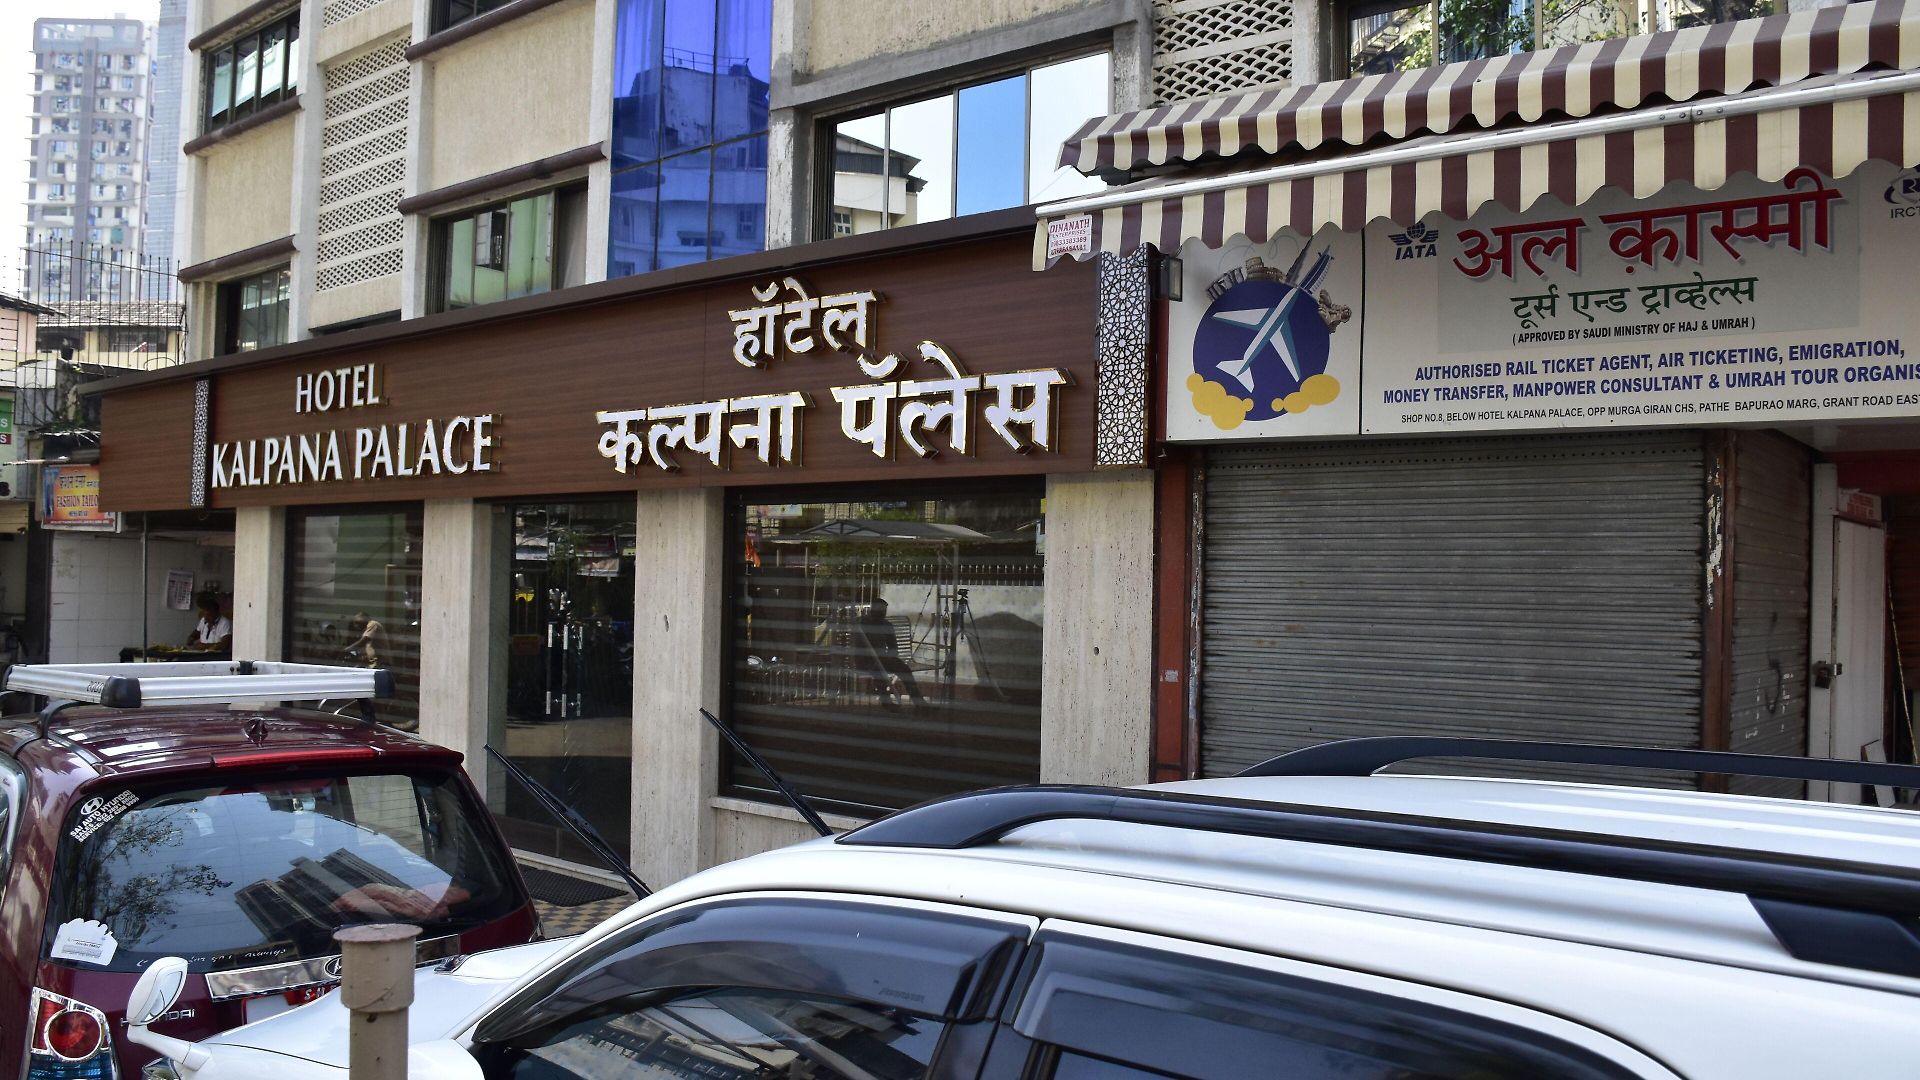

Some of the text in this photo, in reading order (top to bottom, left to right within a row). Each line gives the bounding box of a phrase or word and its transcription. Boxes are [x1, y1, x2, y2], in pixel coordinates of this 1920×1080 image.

[1050, 219, 1090, 233] DINANATH
[1453, 218, 1586, 278] अल
[1396, 244, 1436, 260] IATA
[728, 276, 878, 368] हॉटेल
[1510, 272, 1758, 330] टूर्स एन्ड ट्राव्हेल्स
[1568, 330, 1580, 340] BY
[1583, 327, 1610, 338] SAUDI
[1614, 324, 1660, 336] MINISTRY
[1663, 323, 1675, 333] OF
[1678, 321, 1698, 332] HAJ
[1702, 320, 1708, 330] &
[1415, 339, 1905, 381] AUTHORISED RAIL TICKET AGENT, AIR TICKETING, EMIGRATION,
[296, 362, 381, 413] HOTEL
[595, 340, 1069, 474] कल्पना पॅलेस
[1384, 388, 1429, 404] MONEY
[1434, 385, 1508, 401] TRANSFER,
[1513, 380, 1595, 398] MANPOWER
[1600, 375, 1703, 394] CONSULTANT
[1708, 374, 1719, 389] &
[1726, 370, 1785, 388] UMRAH
[1791, 368, 1839, 385] TOUR
[1402, 414, 1422, 423] SHOP
[1425, 414, 1445, 423] NO.8,
[1447, 412, 1476, 421] BELOW
[1478, 411, 1505, 420] HOTEL
[1508, 409, 1546, 419] KALPANA
[1549, 408, 1585, 418] PALACE,
[1588, 407, 1605, 416] OPP
[1608, 406, 1641, 416] MURGA
[1643, 405, 1672, 414] GIRAN
[1675, 404, 1696, 414] CHS,
[1700, 402, 1729, 412] PATHE
[1735, 400, 1783, 410] BAPURAO
[1787, 399, 1820, 409] MARG,
[1823, 397, 1859, 407] GRANT
[1863, 395, 1893, 406] ROAD
[212, 414, 492, 488] KALPANA PALACE
[56, 496, 80, 507] FASHION
[70, 790, 132, 836] SAI AUTO HYUNDAI
